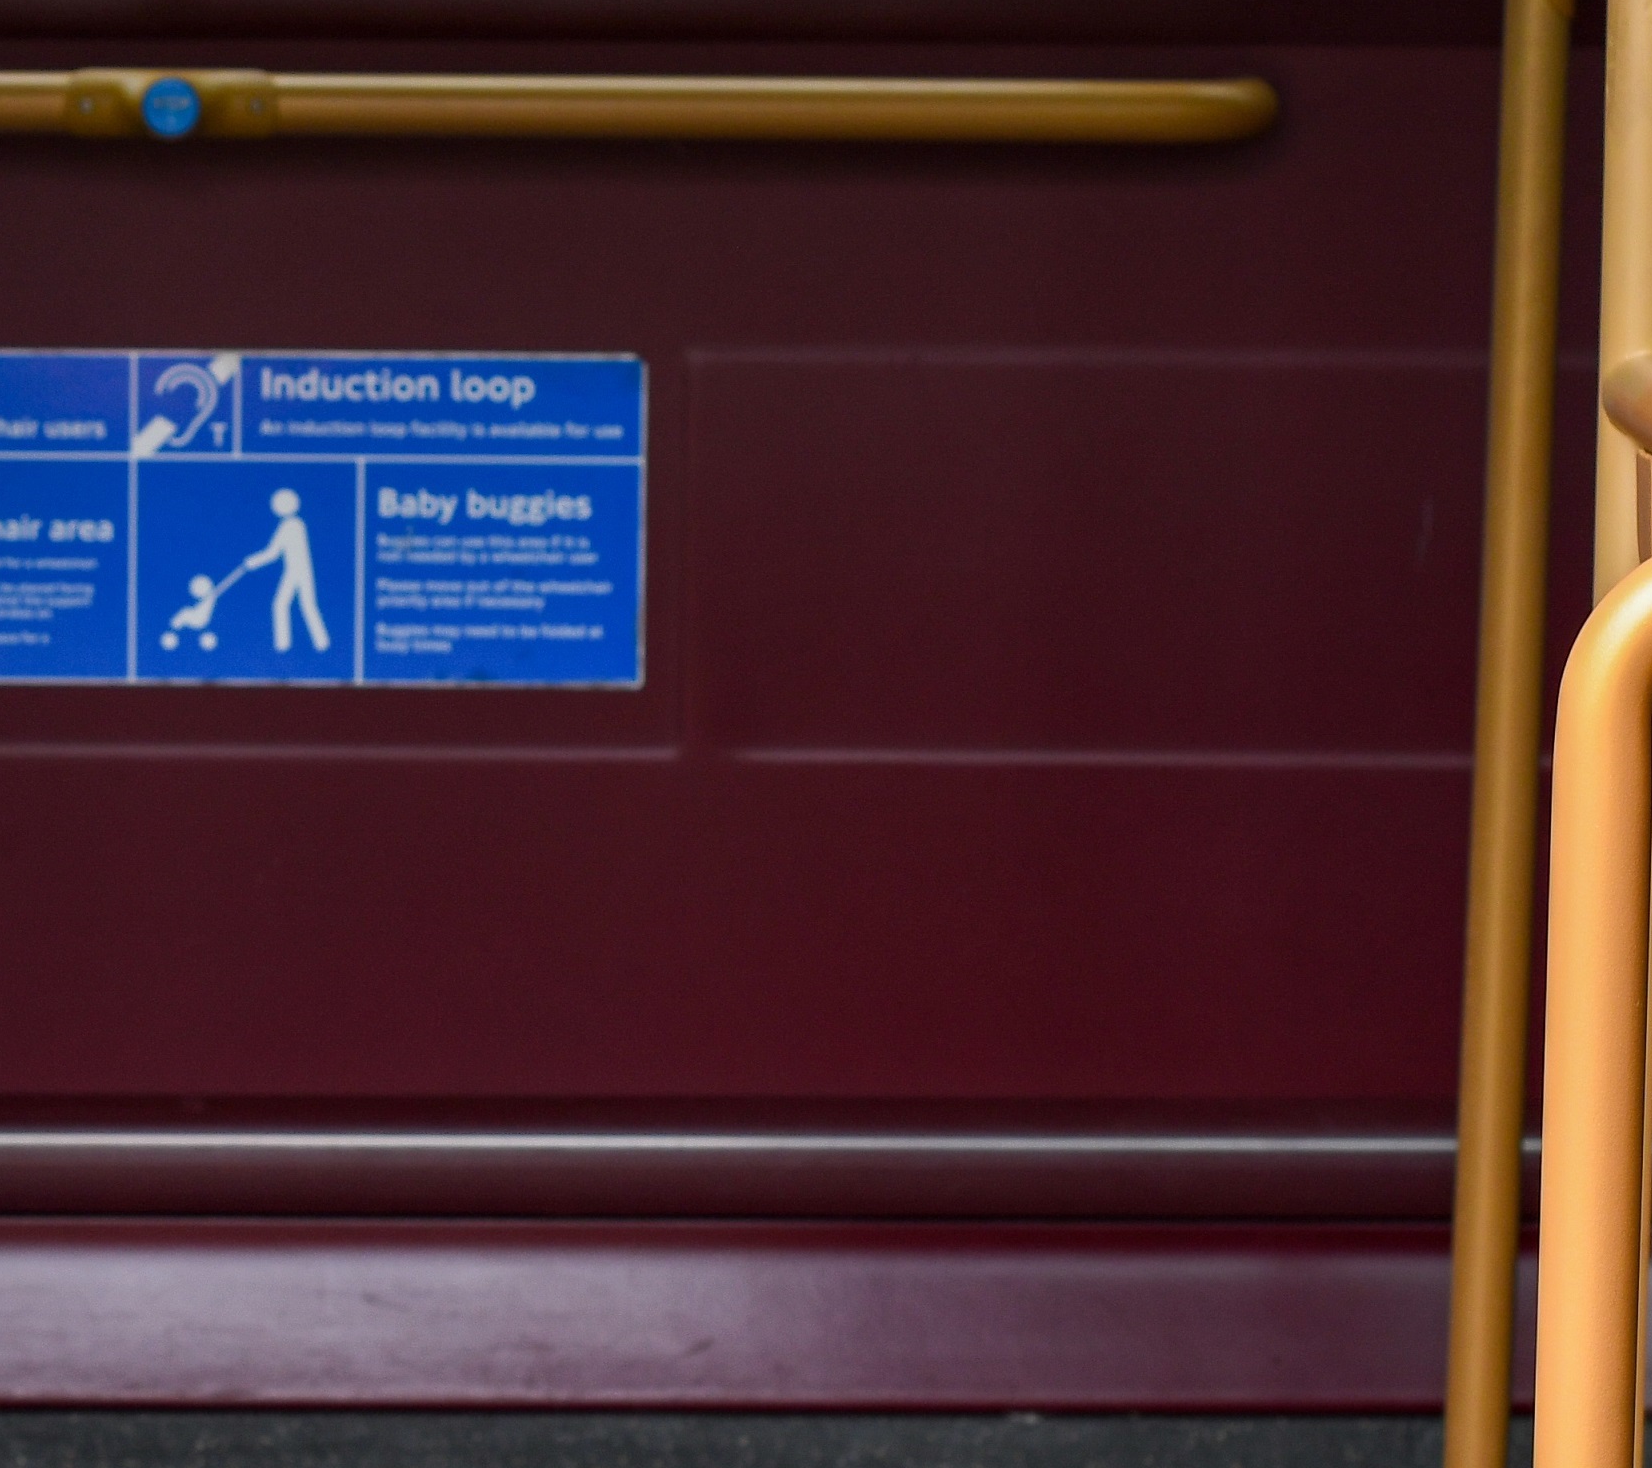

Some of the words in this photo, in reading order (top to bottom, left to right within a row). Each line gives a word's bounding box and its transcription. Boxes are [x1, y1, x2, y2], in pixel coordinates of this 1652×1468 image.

[259, 365, 441, 402] Induction
[449, 367, 537, 409] loop
[376, 486, 459, 525] Baby
[465, 488, 594, 526] buggies
[47, 518, 116, 542] area
